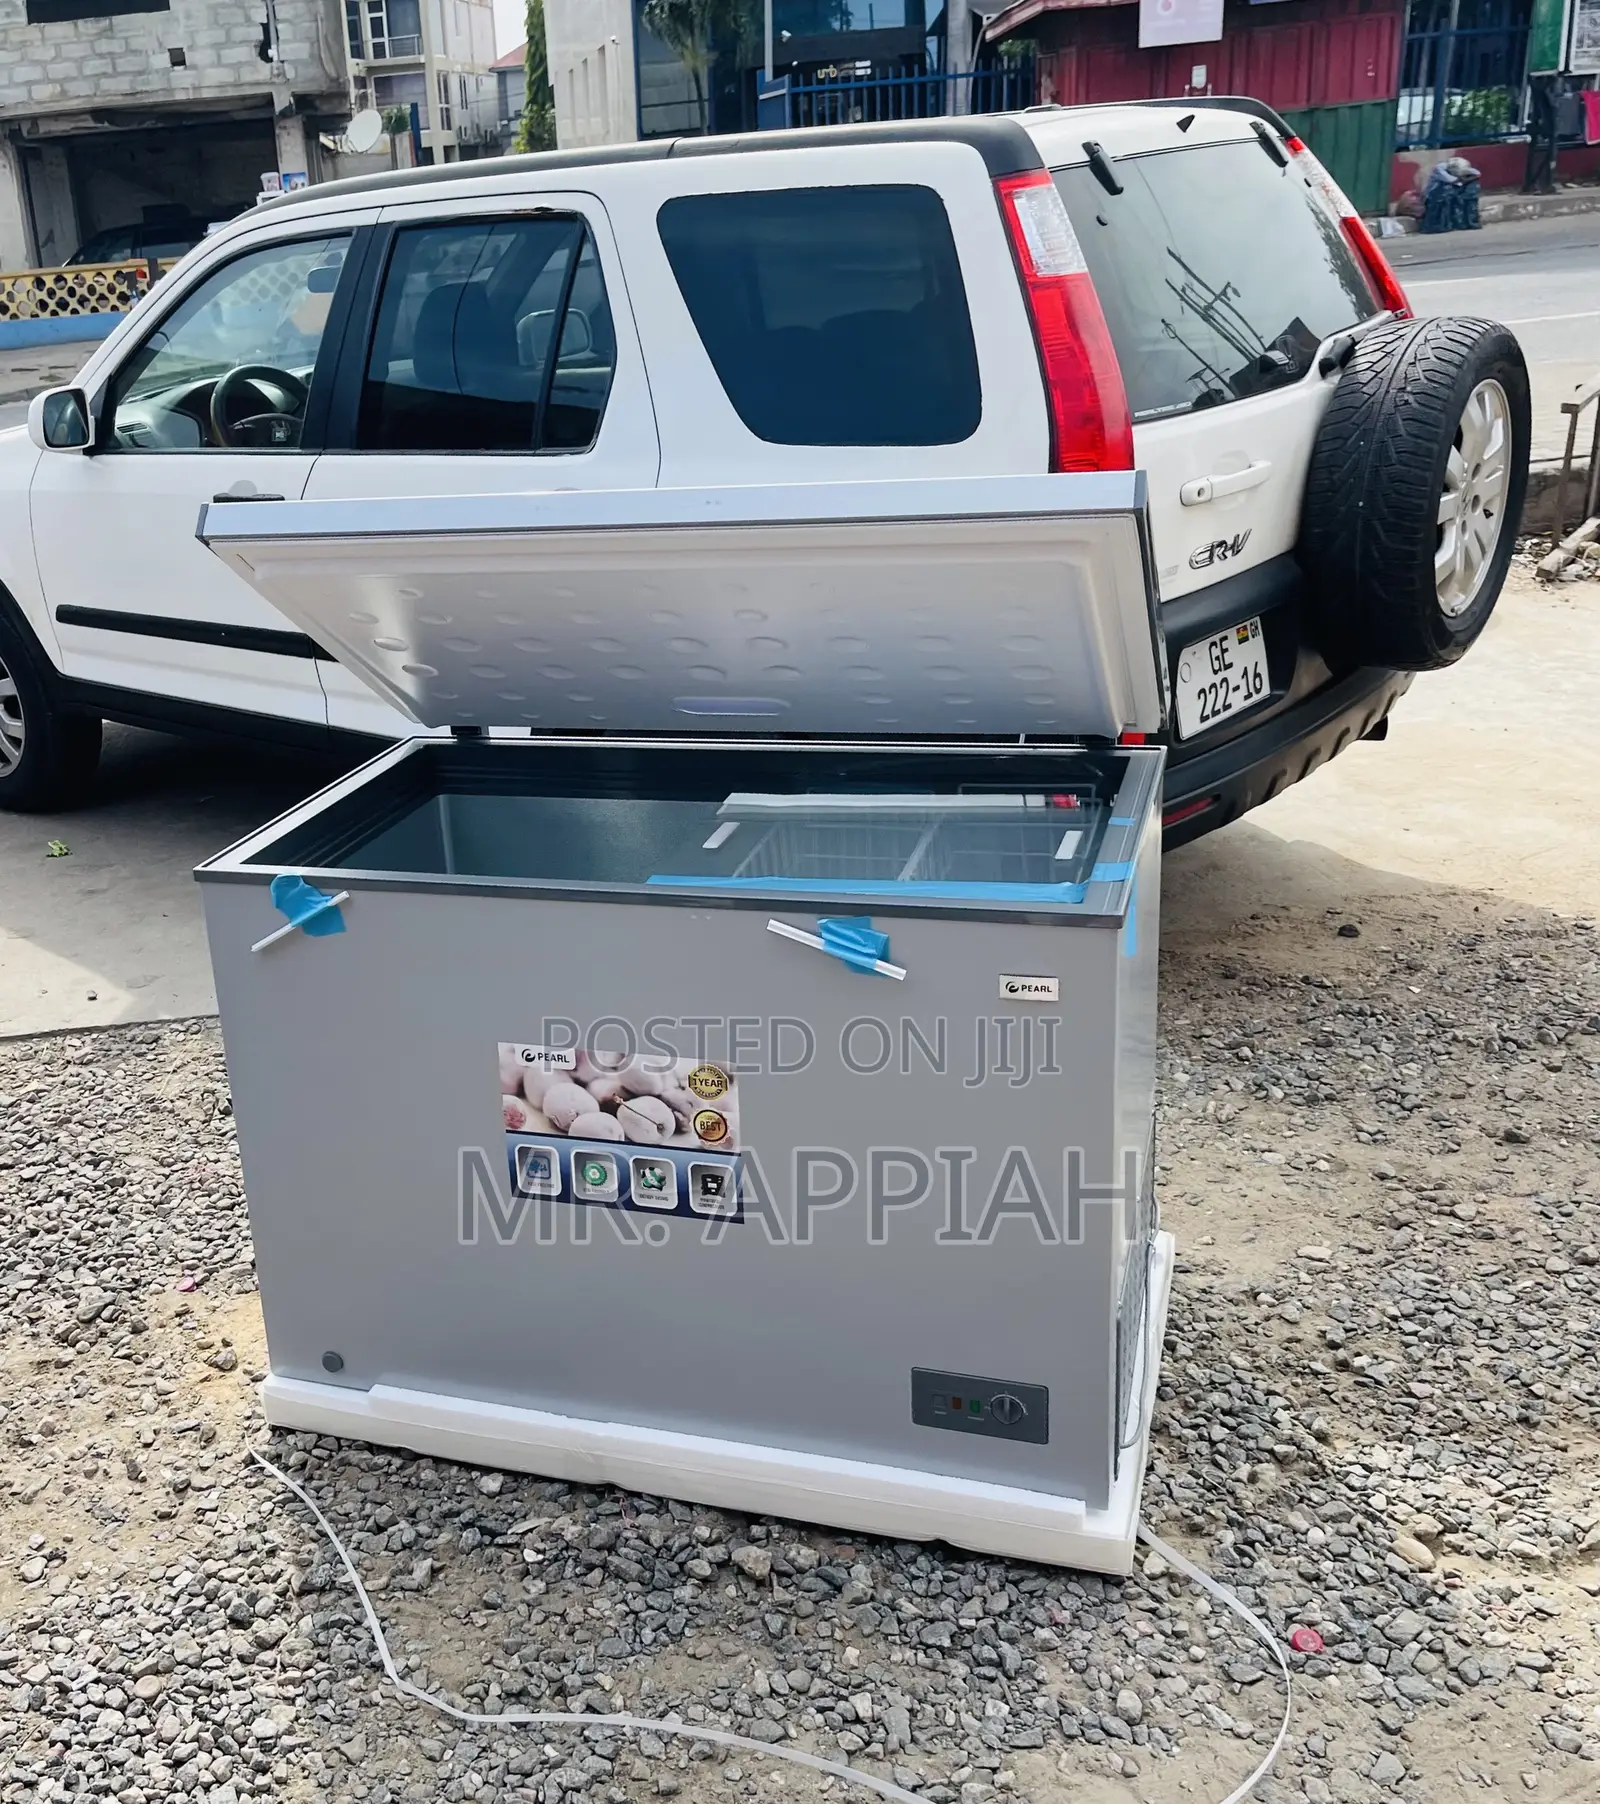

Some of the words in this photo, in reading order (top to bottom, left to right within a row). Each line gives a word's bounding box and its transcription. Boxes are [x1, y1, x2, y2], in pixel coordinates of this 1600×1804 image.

[1208, 635, 1234, 675] GE
[1249, 620, 1261, 639] GH
[1197, 661, 1263, 724] 222-16
[1021, 983, 1053, 993] PEARL
[538, 1051, 570, 1064] PEARL
[698, 1078, 723, 1088] YEAR
[700, 1120, 722, 1132] BEST
